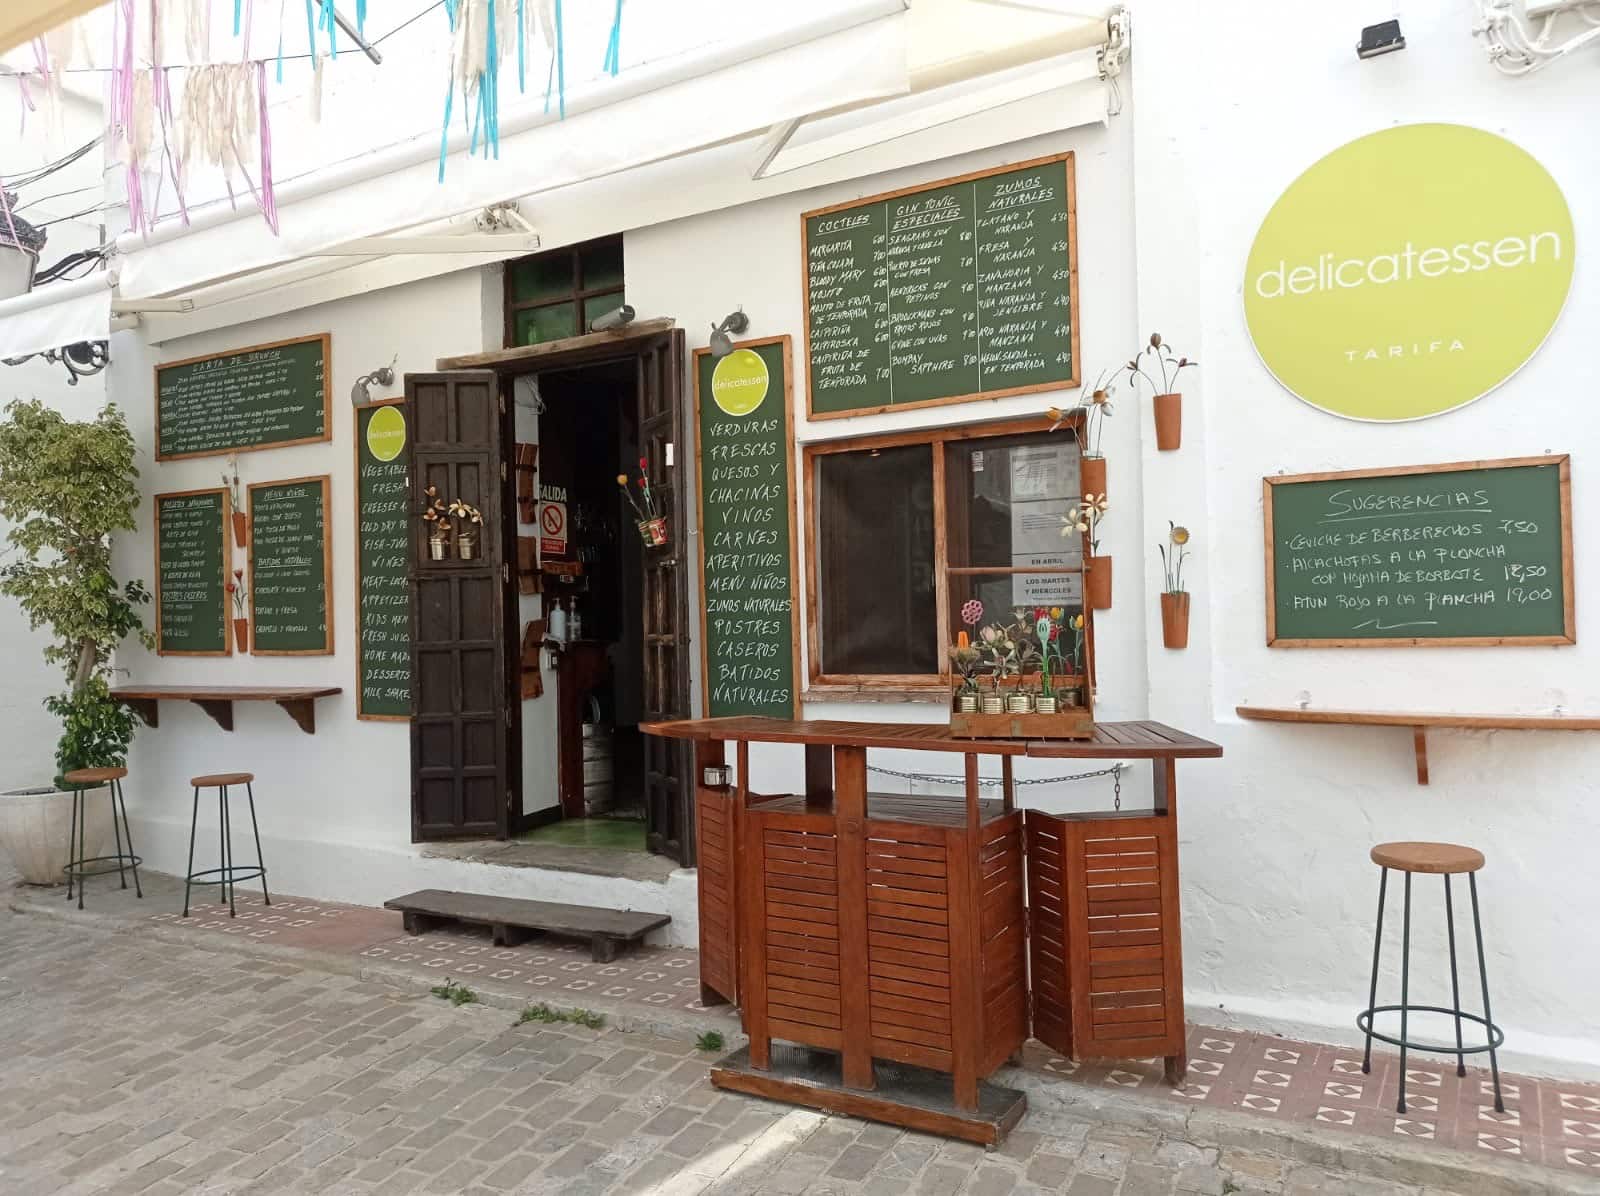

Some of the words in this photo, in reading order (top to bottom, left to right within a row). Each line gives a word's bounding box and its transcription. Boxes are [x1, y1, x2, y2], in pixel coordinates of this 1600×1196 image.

[996, 176, 1041, 195] ZUMOS
[988, 187, 1054, 208] NATURALES
[896, 203, 920, 216] GIN
[818, 214, 870, 232] COCTELES
[892, 208, 960, 230] ESPECIALES
[977, 212, 1020, 227] PLATANO
[1026, 209, 1034, 220] Y
[994, 220, 1034, 234] NARANJA
[810, 240, 852, 257] MARGARITA
[979, 241, 1009, 254] FRESA
[1023, 236, 1034, 248] Y
[993, 248, 1036, 262] NARANJA
[1256, 230, 1560, 298] delicatessen
[838, 268, 866, 283] MARY
[978, 266, 1030, 282] ZANAHORIA
[1037, 264, 1044, 276] Y
[934, 280, 952, 290] CON
[985, 277, 1032, 294] MANZANA
[810, 287, 843, 303] MOJITO
[848, 295, 872, 306] FRUTA
[998, 292, 1036, 306] NARANJA
[1040, 290, 1048, 299] Y
[940, 308, 956, 316] CON
[998, 320, 1037, 334] NARANJA
[1041, 320, 1048, 328] Y
[914, 336, 928, 346] CON
[928, 334, 948, 344] UVAS
[989, 332, 1034, 348] MANZANA
[856, 349, 871, 358] DE
[1346, 339, 1464, 361] TARIFA
[891, 353, 924, 366] BOMBAY
[1000, 359, 1045, 373] TEMPORADA
[821, 364, 845, 376] FRUTA
[850, 362, 864, 371] DE
[819, 374, 868, 390] TEMPORADA
[710, 419, 778, 437] VERDURAS
[710, 442, 777, 462] FRESCAS
[712, 464, 760, 481] QUESOS
[770, 462, 780, 476] Y
[709, 484, 781, 504] CHACINAS
[362, 501, 398, 514] CHEESES
[722, 506, 775, 524] VINOS
[713, 530, 778, 549] CARNES
[1290, 534, 1342, 550] CEVICHE
[1345, 532, 1368, 544] DE
[1370, 524, 1482, 542] BERBERECHOS
[707, 554, 782, 572] APERITIVOS
[1390, 551, 1401, 564] A
[1408, 550, 1426, 561] LA
[750, 572, 786, 591] NIÑOS
[1312, 572, 1336, 585] CON
[1395, 570, 1414, 583] DE
[707, 600, 740, 612] ZUMOS
[744, 599, 793, 615] NATURALES
[1294, 595, 1327, 609] ATUN
[1378, 595, 1388, 606] A
[1396, 594, 1416, 606] LA
[1424, 590, 1495, 612] PLANCHA
[366, 612, 388, 626] KIDS
[714, 618, 781, 638] POSTRES
[362, 629, 387, 644] FRESH
[364, 648, 387, 662] HOME
[717, 641, 780, 660] CASEROS
[366, 669, 410, 680] DESSERTS
[718, 664, 781, 682] BATIDOS
[364, 687, 382, 700] MILK
[713, 683, 788, 705] NATURALES
